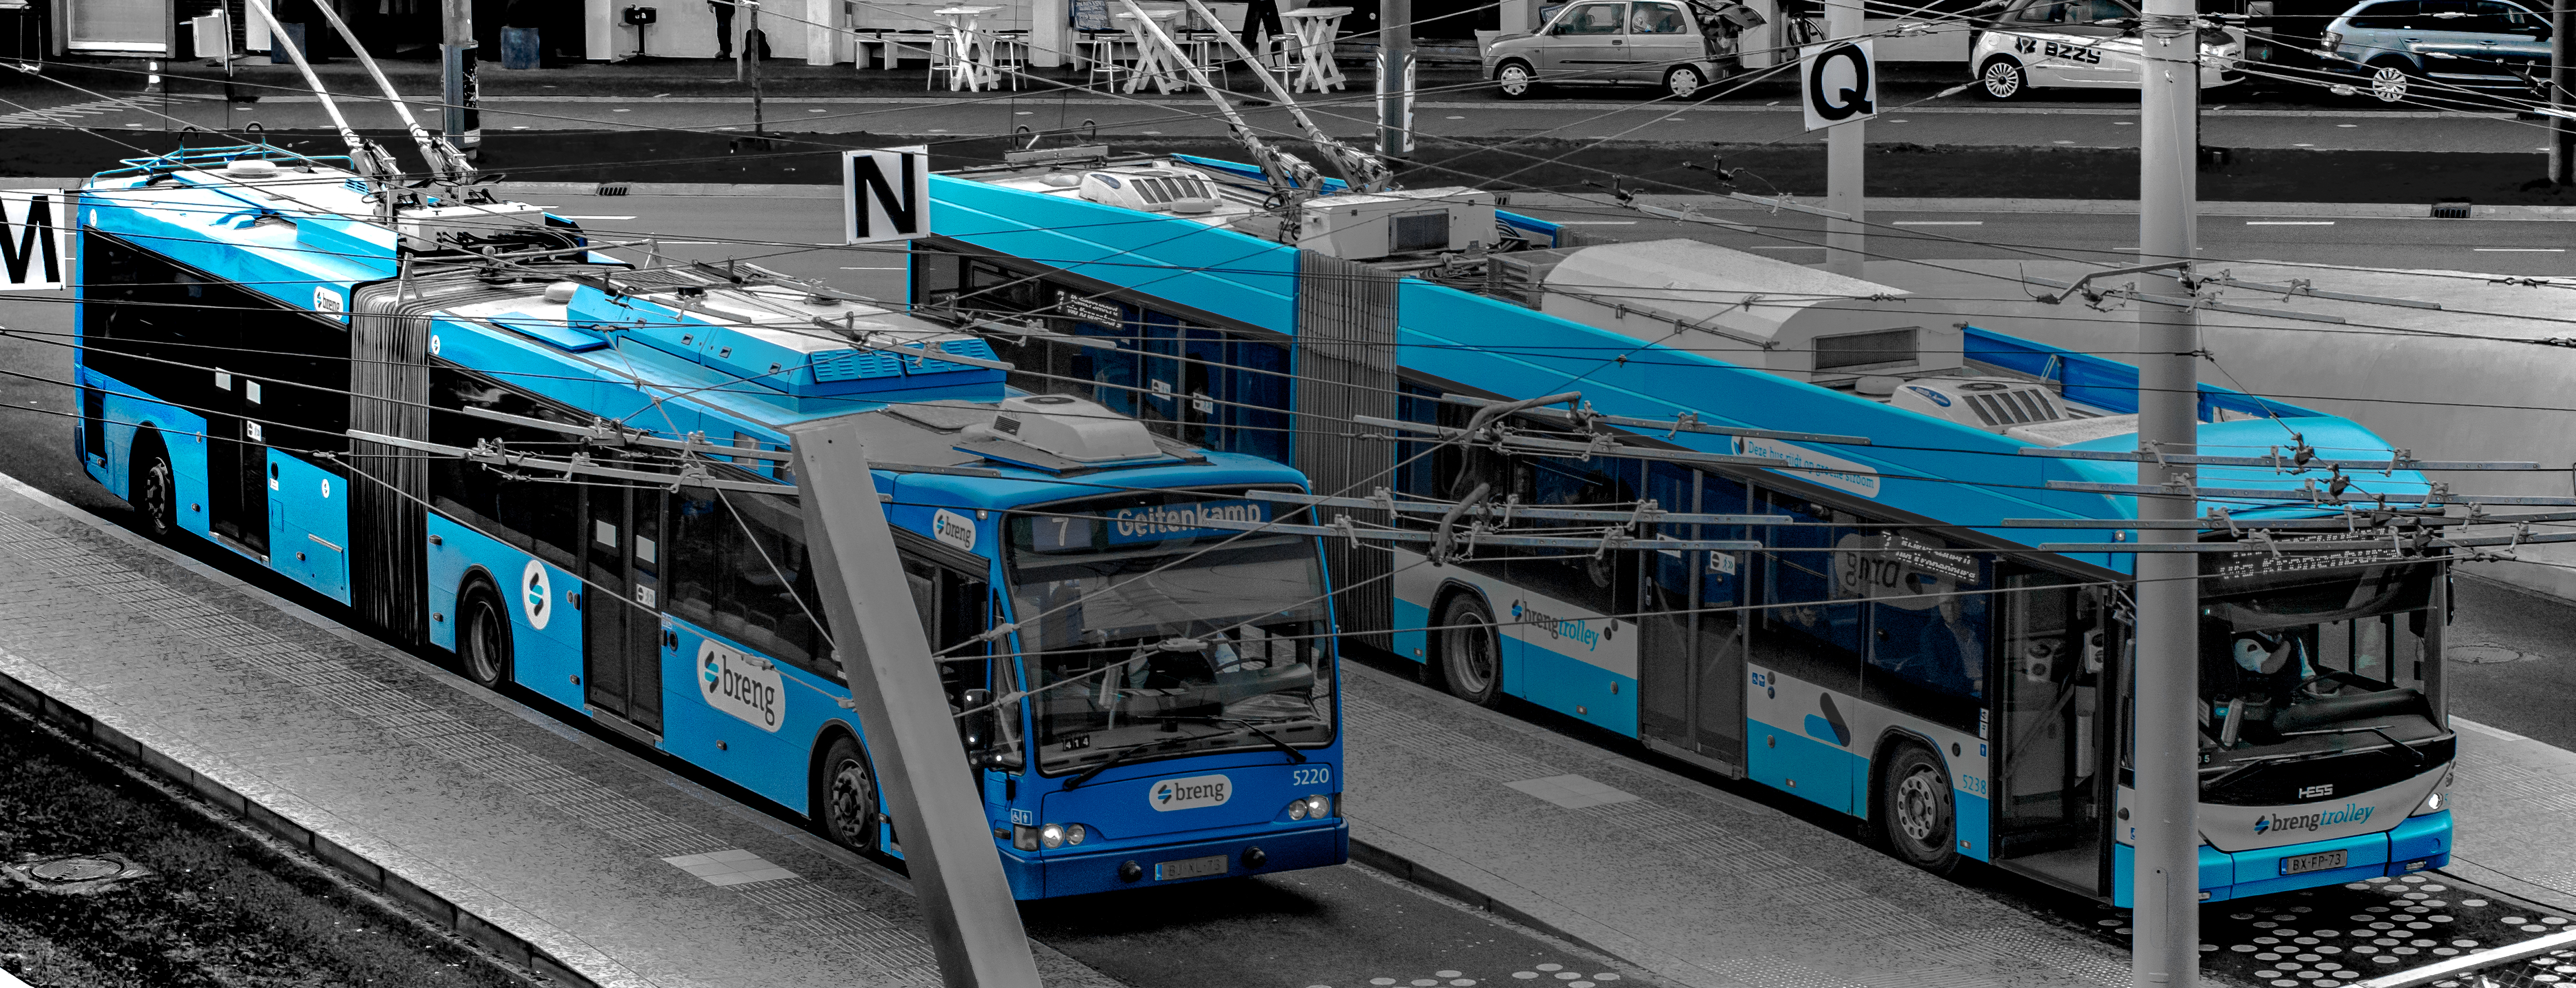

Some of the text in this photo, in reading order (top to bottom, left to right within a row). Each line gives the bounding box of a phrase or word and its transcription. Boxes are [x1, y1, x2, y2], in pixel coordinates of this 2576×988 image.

[2045, 42, 2101, 64] BZZY
[1810, 42, 1873, 121] Q
[853, 153, 917, 238] N
[0, 195, 61, 284] M
[1748, 441, 1767, 457] Deze
[1846, 473, 1875, 489] stroom
[945, 516, 971, 548] breng
[1052, 517, 1069, 546] 7
[722, 654, 775, 726] breng
[1066, 737, 1089, 749] 414
[1175, 782, 1224, 801] breng
[1294, 768, 1329, 786] 5220
[1963, 774, 1986, 795] 5238
[2298, 784, 2333, 799] HESS
[2272, 803, 2375, 832] brengtrolley
[2293, 854, 2341, 871] BX-FP-73
